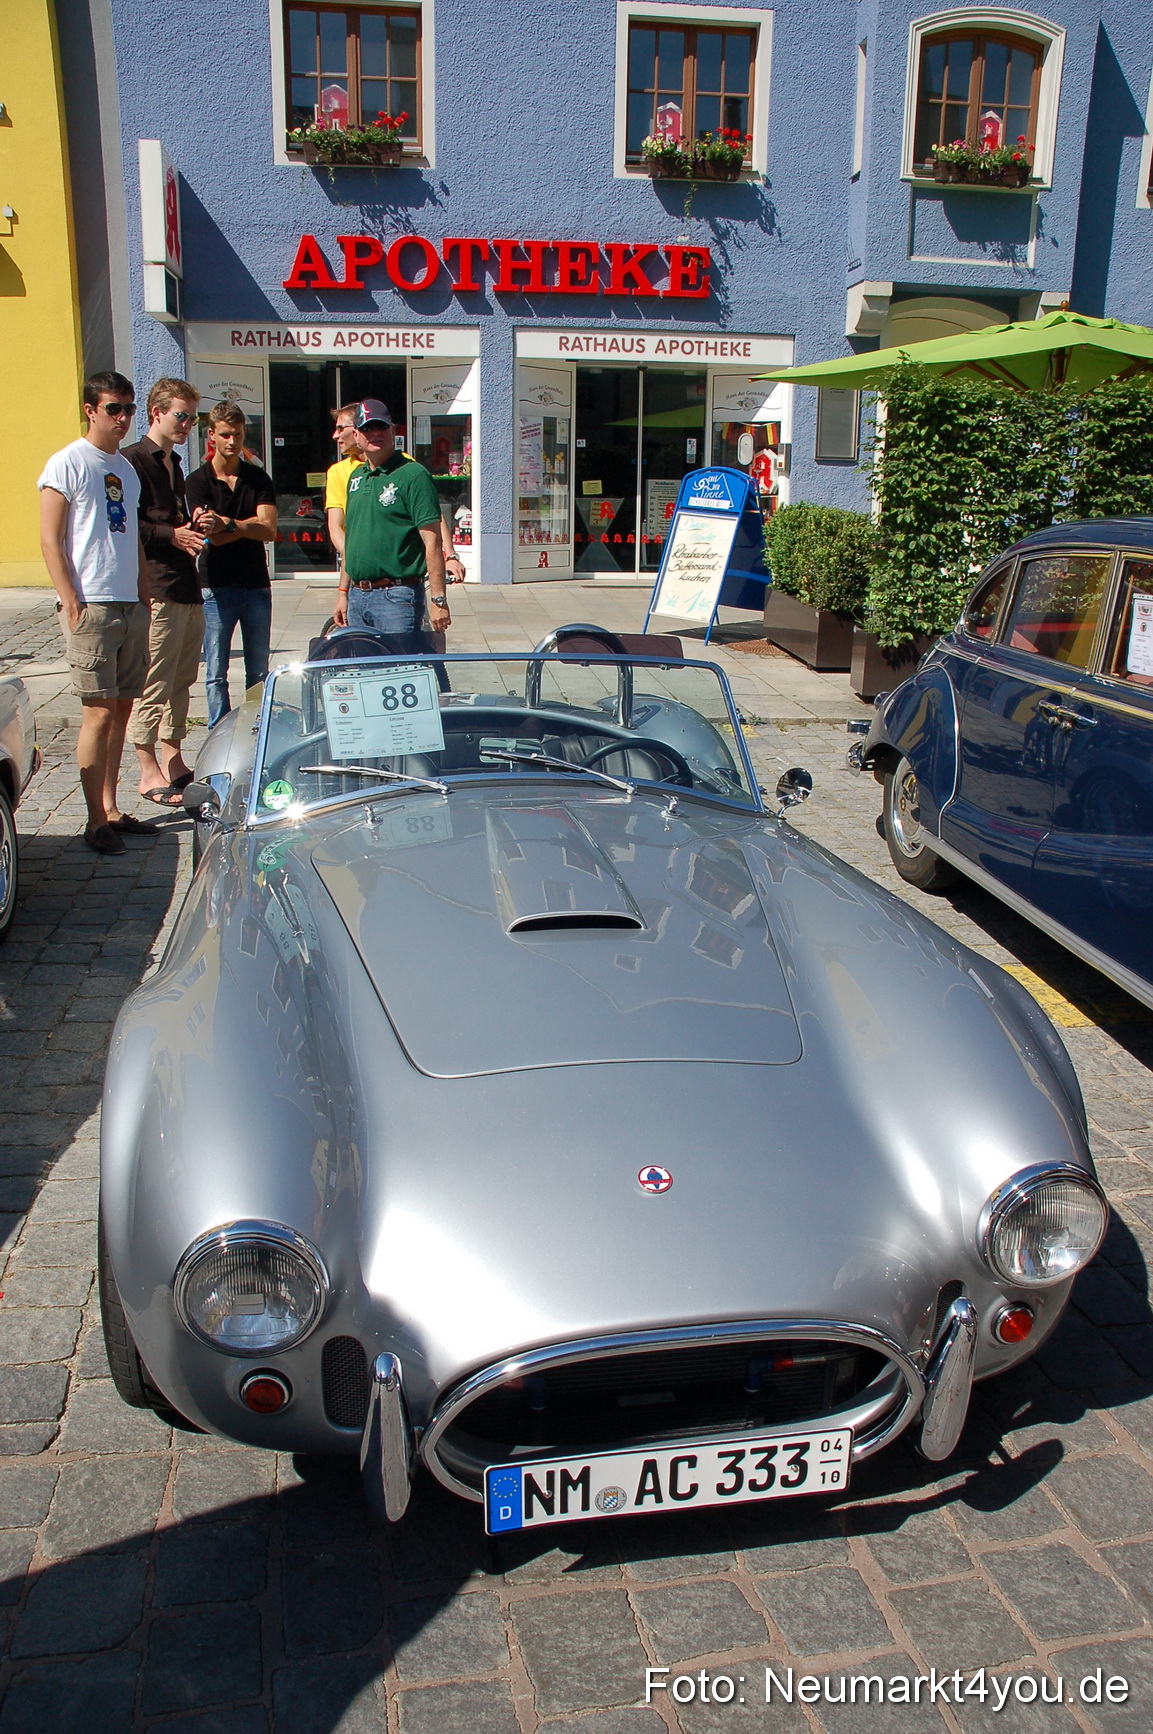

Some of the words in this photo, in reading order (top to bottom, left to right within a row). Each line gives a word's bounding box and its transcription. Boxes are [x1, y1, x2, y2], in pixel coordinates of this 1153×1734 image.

[282, 234, 711, 299] APOTHEKE
[230, 330, 322, 348] RATHAUS
[333, 331, 435, 349] APOTHEKE
[558, 336, 646, 354] RATHAUS
[654, 339, 751, 357] APOTHEKE
[671, 543, 724, 560] Rhabarber-
[679, 571, 712, 583] kuchen
[381, 683, 419, 711] 88
[274, 781, 283, 795] 4
[820, 1439, 843, 1453] 04
[524, 1465, 591, 1520] NM
[633, 1455, 698, 1506] AC
[716, 1441, 811, 1497] 333
[820, 1471, 841, 1485] 10
[499, 1506, 512, 1520] D
